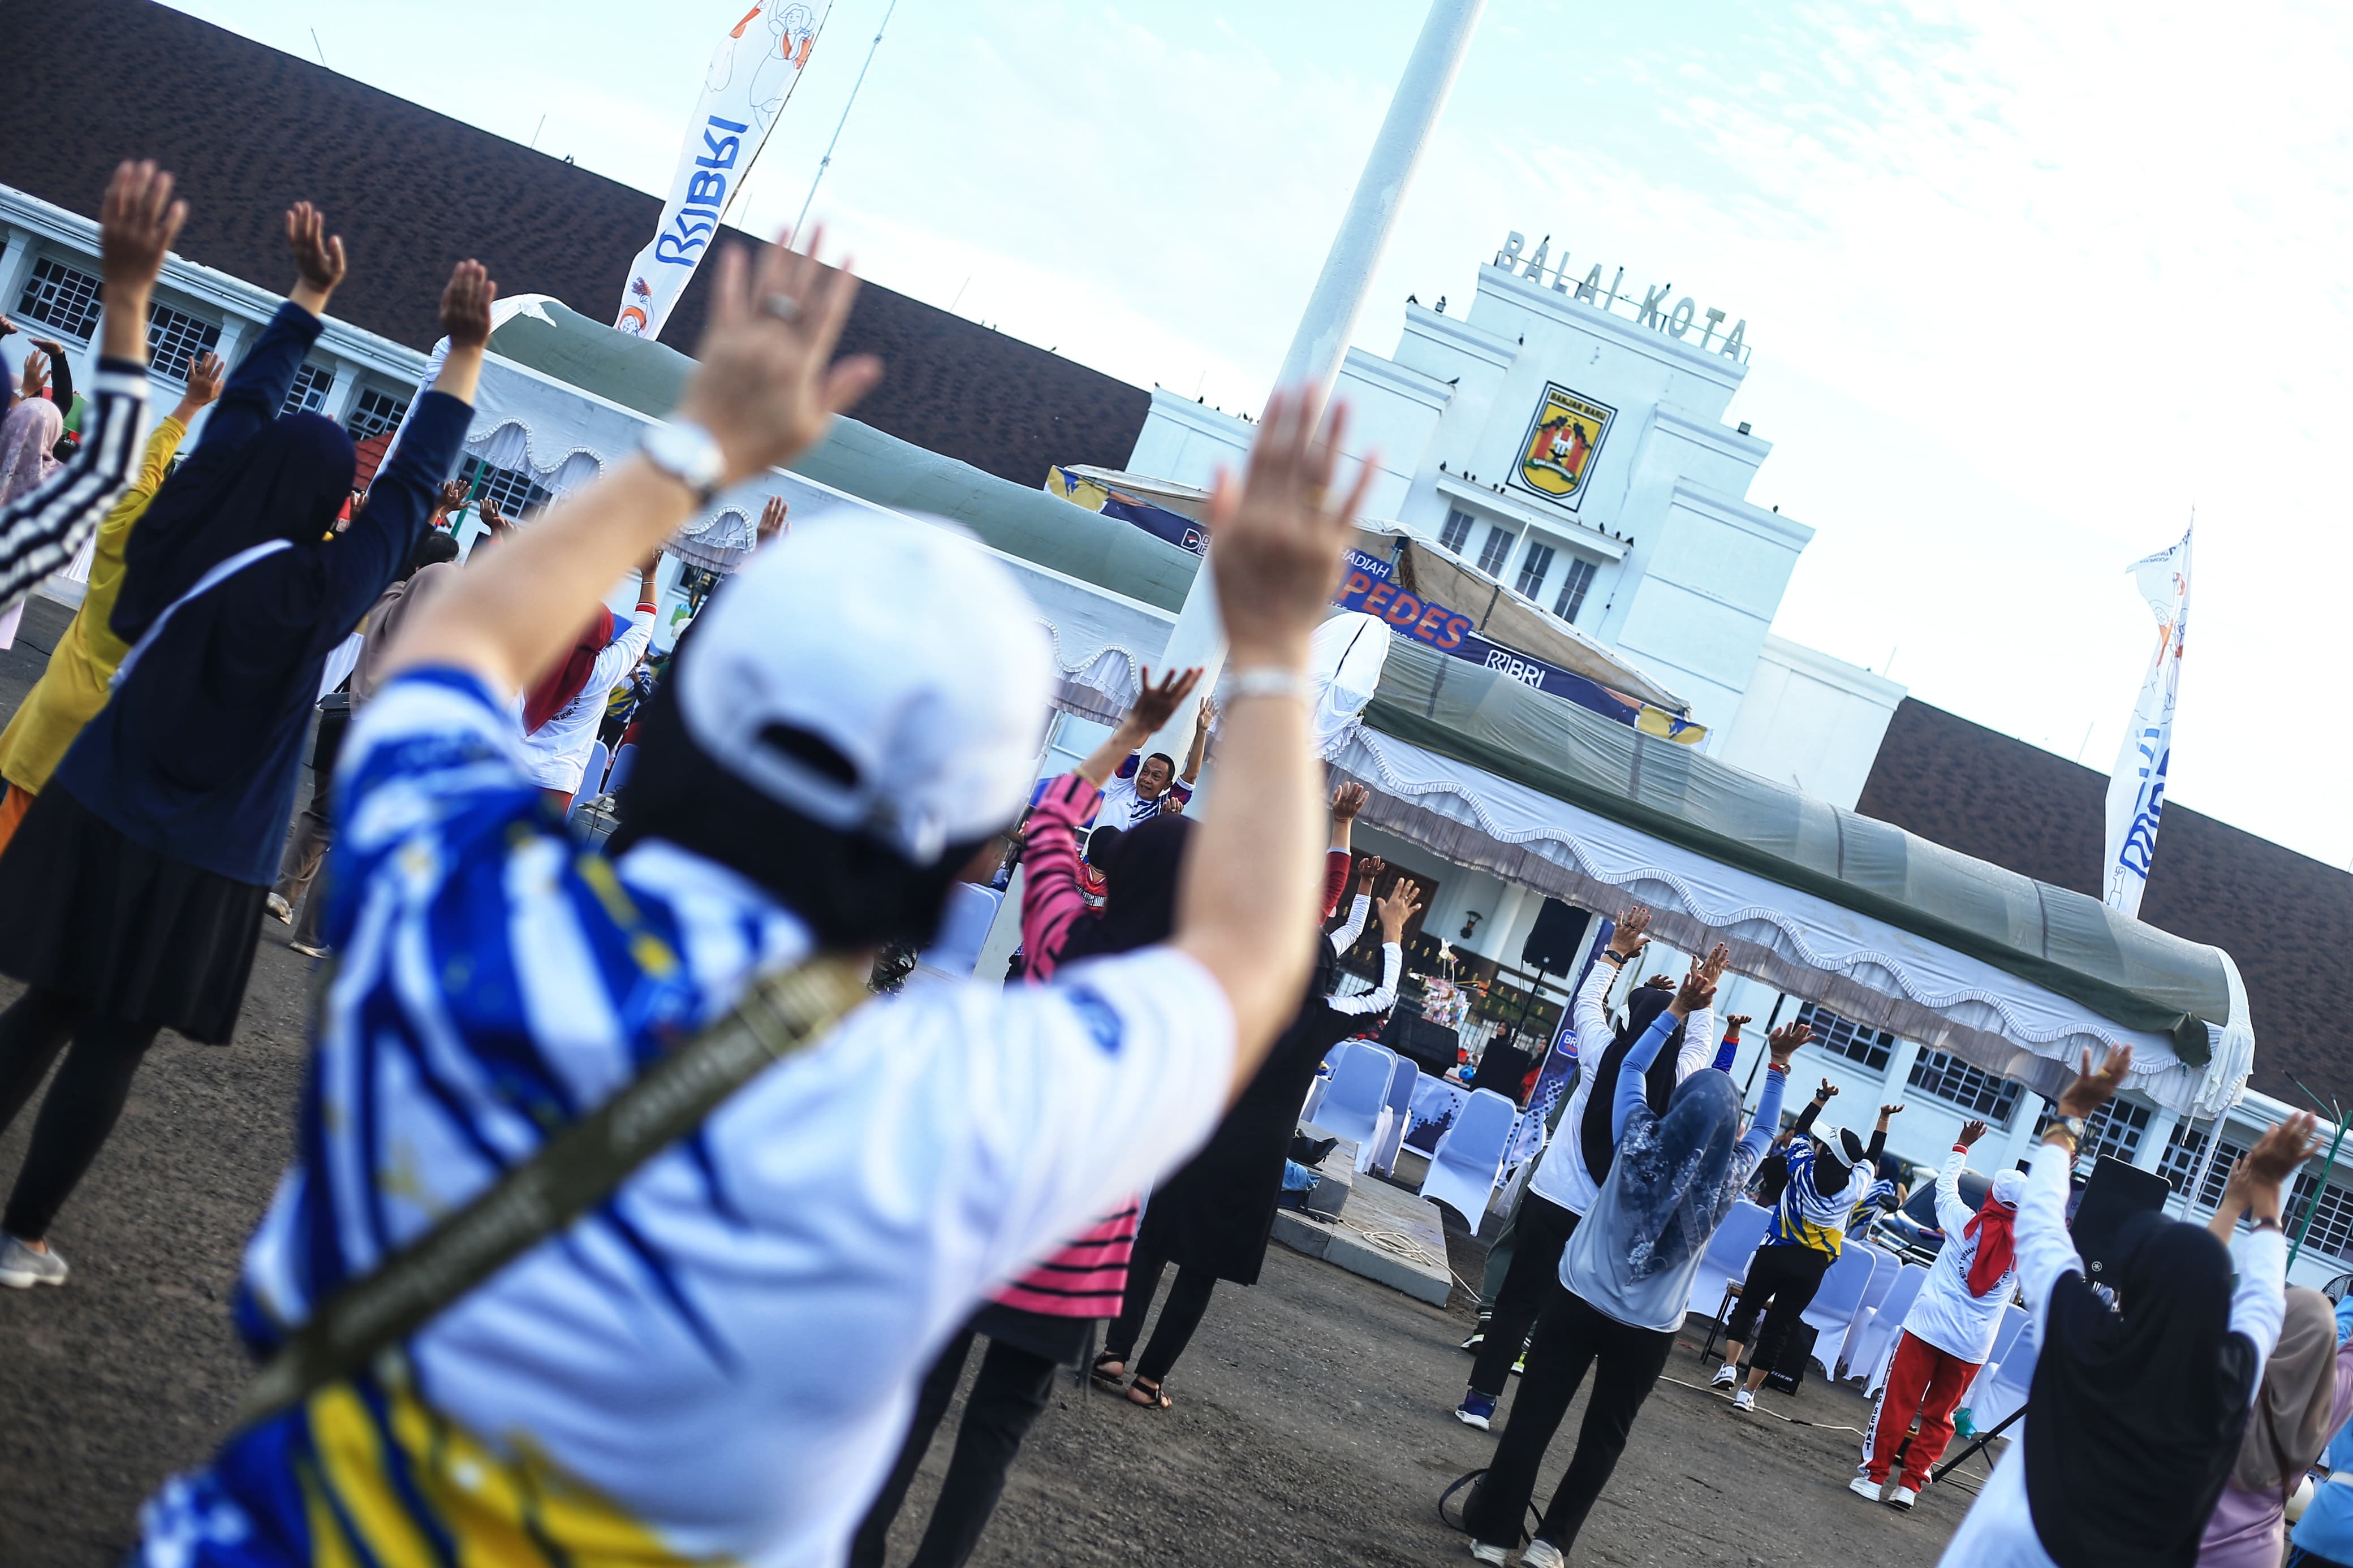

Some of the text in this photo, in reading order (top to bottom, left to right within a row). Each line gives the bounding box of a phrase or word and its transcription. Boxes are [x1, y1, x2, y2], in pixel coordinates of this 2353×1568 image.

[1498, 231, 1746, 362] BALAI KOTA
[1338, 571, 1469, 649] PEDES
[1507, 658, 1546, 688] BRI
[560, 709, 575, 720] SEHAT
[1563, 1034, 1578, 1047] BR
[1989, 1282, 2001, 1291] EHAT
[1865, 1407, 1878, 1450] SEHAT
